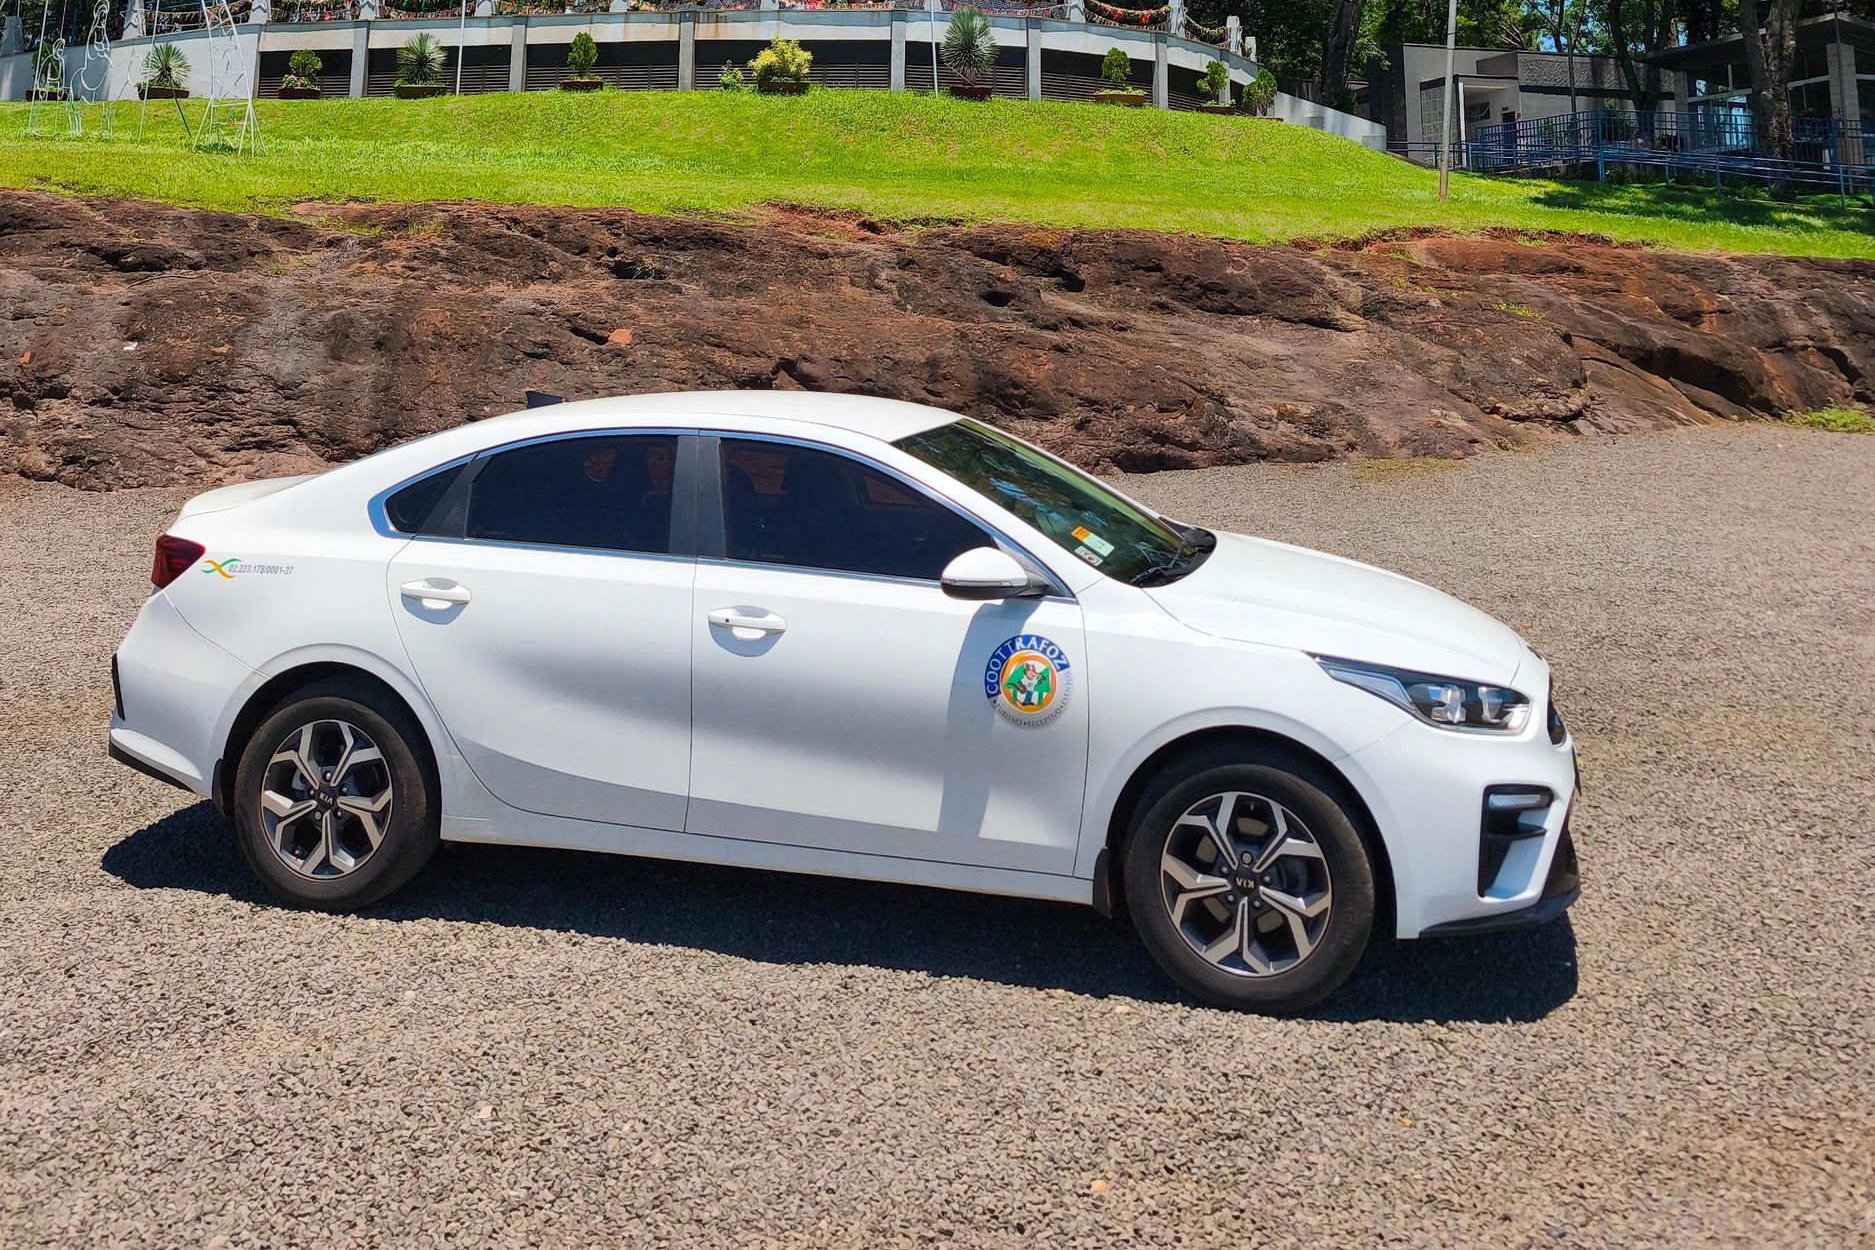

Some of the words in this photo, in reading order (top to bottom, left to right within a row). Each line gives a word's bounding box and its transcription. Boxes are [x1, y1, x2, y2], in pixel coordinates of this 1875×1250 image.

[986, 636, 1070, 694] COOTTRAFOZ
[319, 792, 333, 805] KIA
[1236, 877, 1254, 889] KIA
